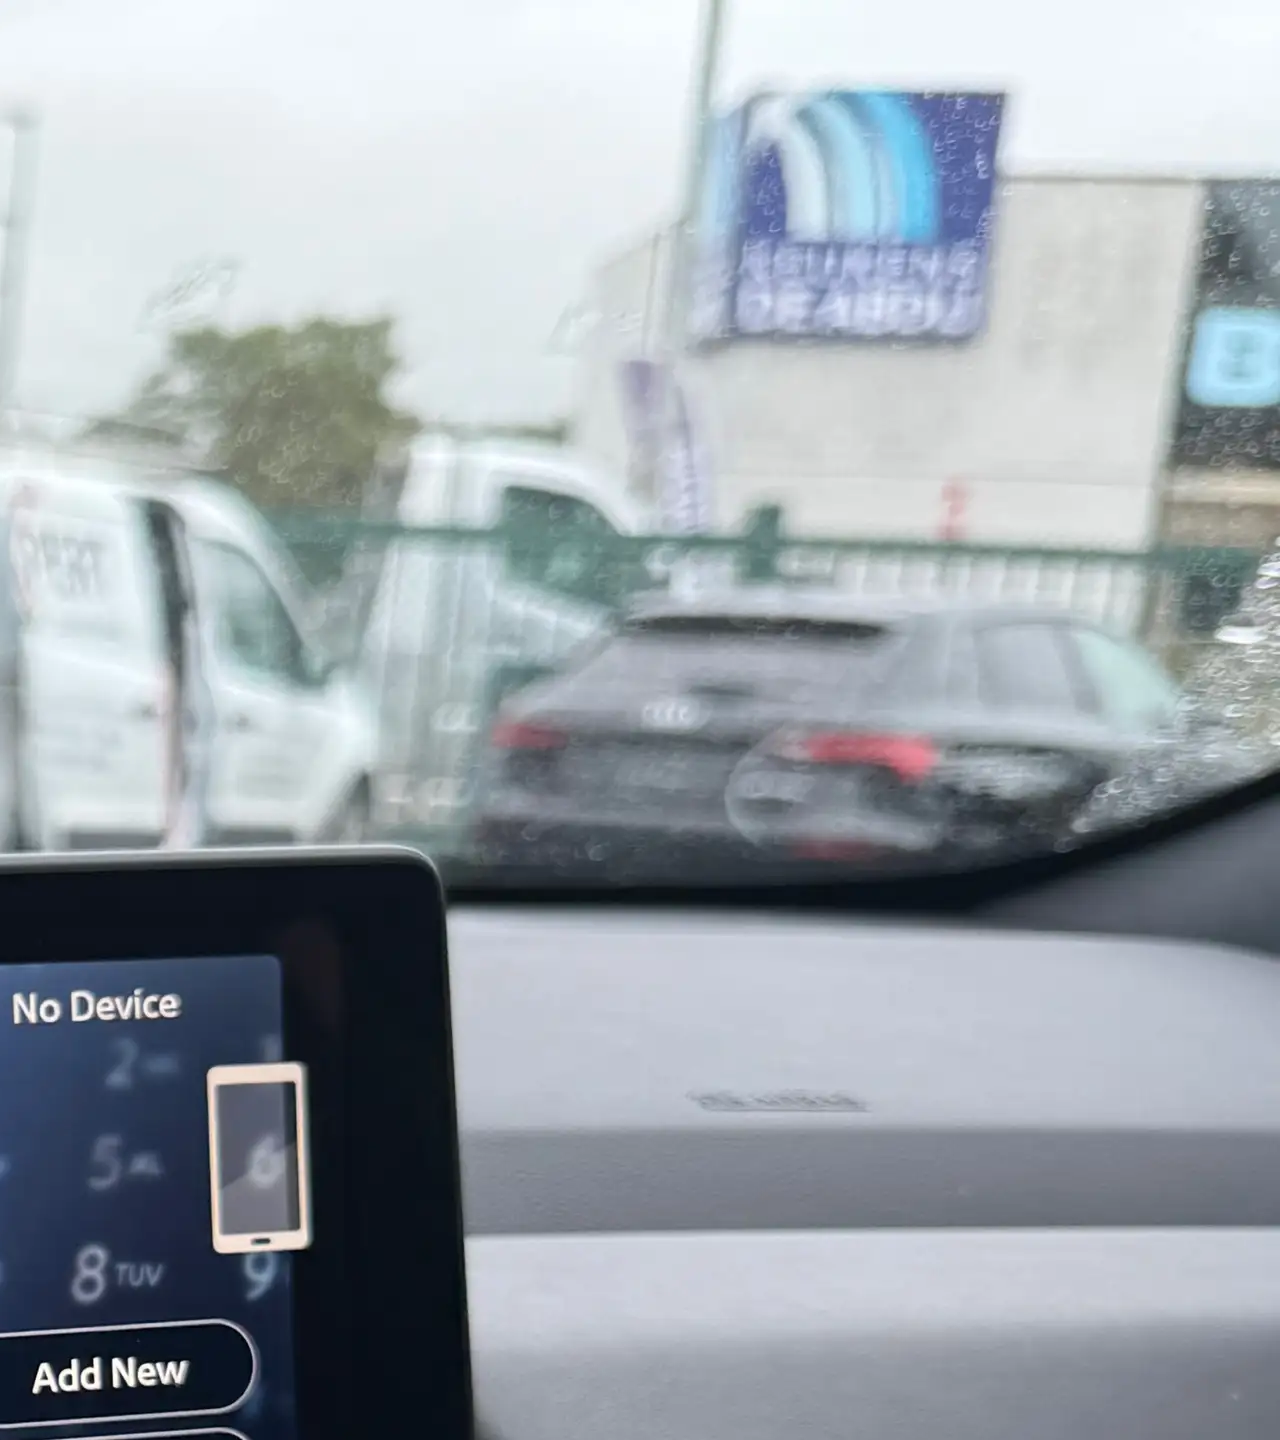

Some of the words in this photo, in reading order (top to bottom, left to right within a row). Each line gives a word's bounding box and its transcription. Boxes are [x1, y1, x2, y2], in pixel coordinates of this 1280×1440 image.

[12, 991, 63, 1025] No
[70, 987, 183, 1022] Device
[72, 1245, 108, 1303] 8
[116, 1263, 164, 1286] TUV
[32, 1357, 104, 1394] Add
[111, 1356, 190, 1388] New
